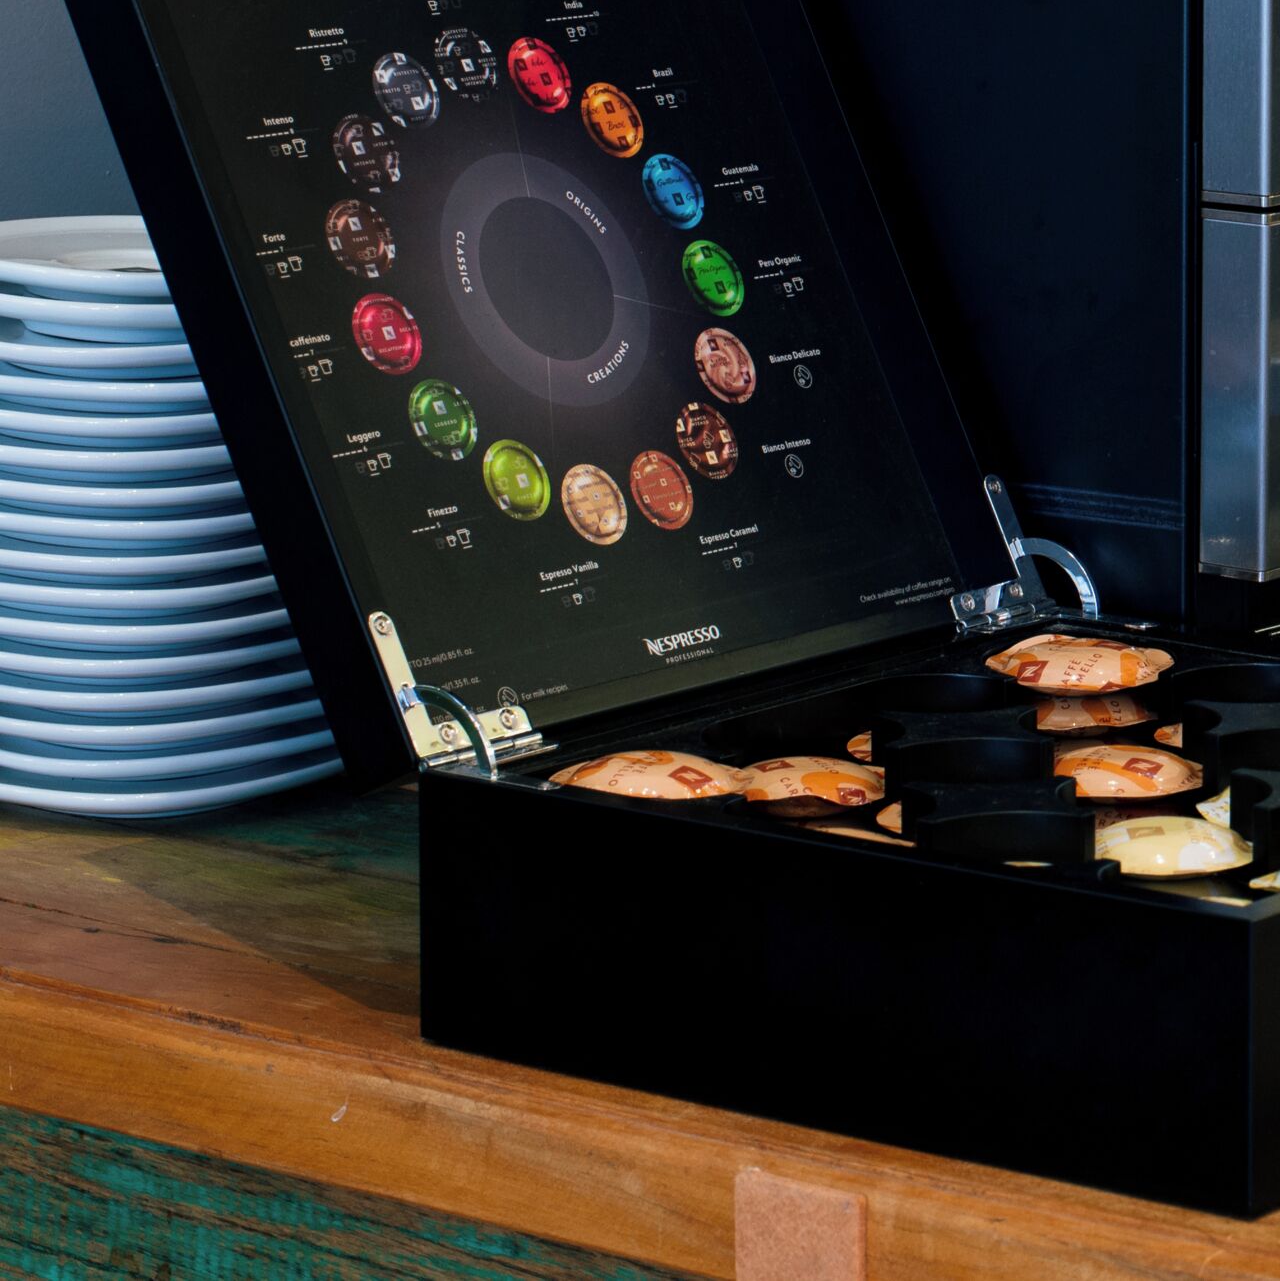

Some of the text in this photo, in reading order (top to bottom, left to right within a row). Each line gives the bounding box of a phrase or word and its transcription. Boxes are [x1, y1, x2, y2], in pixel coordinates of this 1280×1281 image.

[563, 0, 583, 10] India
[308, 27, 344, 38] Ristretto
[652, 67, 673, 78] Brazil
[263, 116, 294, 127] Intenso
[722, 163, 759, 176] Guatemala
[565, 190, 607, 234] ORIGINS
[262, 232, 286, 244] Forte
[456, 230, 473, 294] CLASSICS
[758, 254, 802, 268] Peru Organic
[587, 340, 629, 384] CREATIONS
[769, 349, 821, 364] Bianco Delicato
[346, 430, 381, 444] Leggero
[761, 438, 811, 454] Bianco Intenso
[427, 505, 458, 518] Finezzo
[699, 524, 759, 545] Espresso Caramel
[539, 560, 599, 581] Espresso Vanilla
[642, 624, 720, 656] NESPRESSO
[422, 656, 432, 666] 25
[665, 647, 714, 665] PROFESSIONAL
[1061, 659, 1083, 686] AFFÈ
[521, 684, 569, 701] For milk recipes
